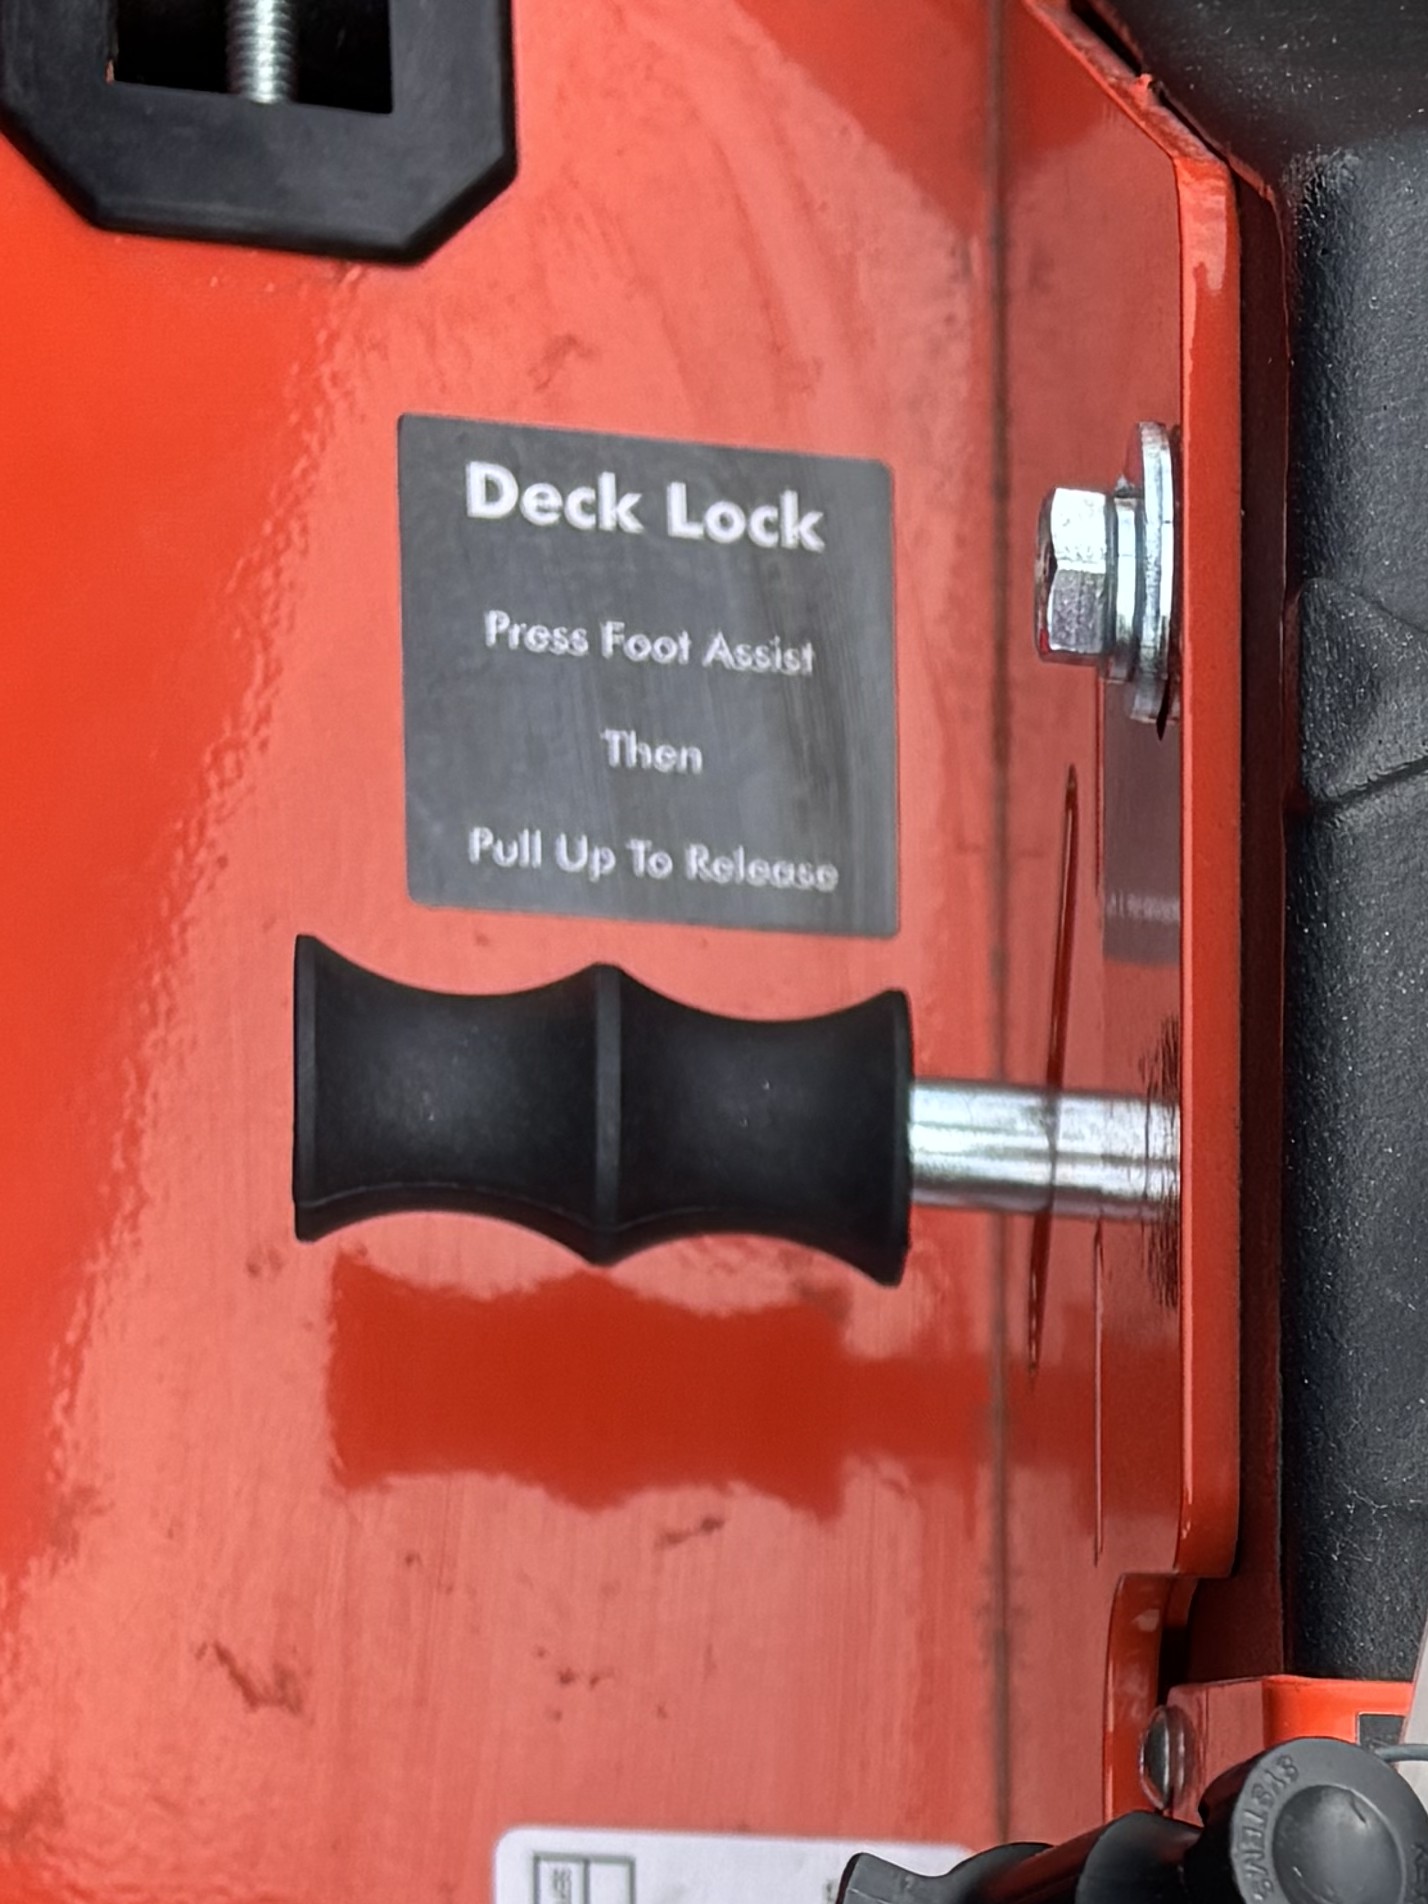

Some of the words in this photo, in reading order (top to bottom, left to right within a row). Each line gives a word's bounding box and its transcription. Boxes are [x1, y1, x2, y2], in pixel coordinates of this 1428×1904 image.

[465, 460, 645, 535] Deck
[666, 481, 827, 554] Lock
[483, 610, 590, 657] Press
[600, 620, 691, 664] Foot
[702, 631, 816, 676] Assist
[601, 728, 702, 774] Then
[468, 826, 543, 869] Pull
[555, 833, 616, 882] Up
[626, 838, 674, 880] To
[685, 844, 840, 892] Release
